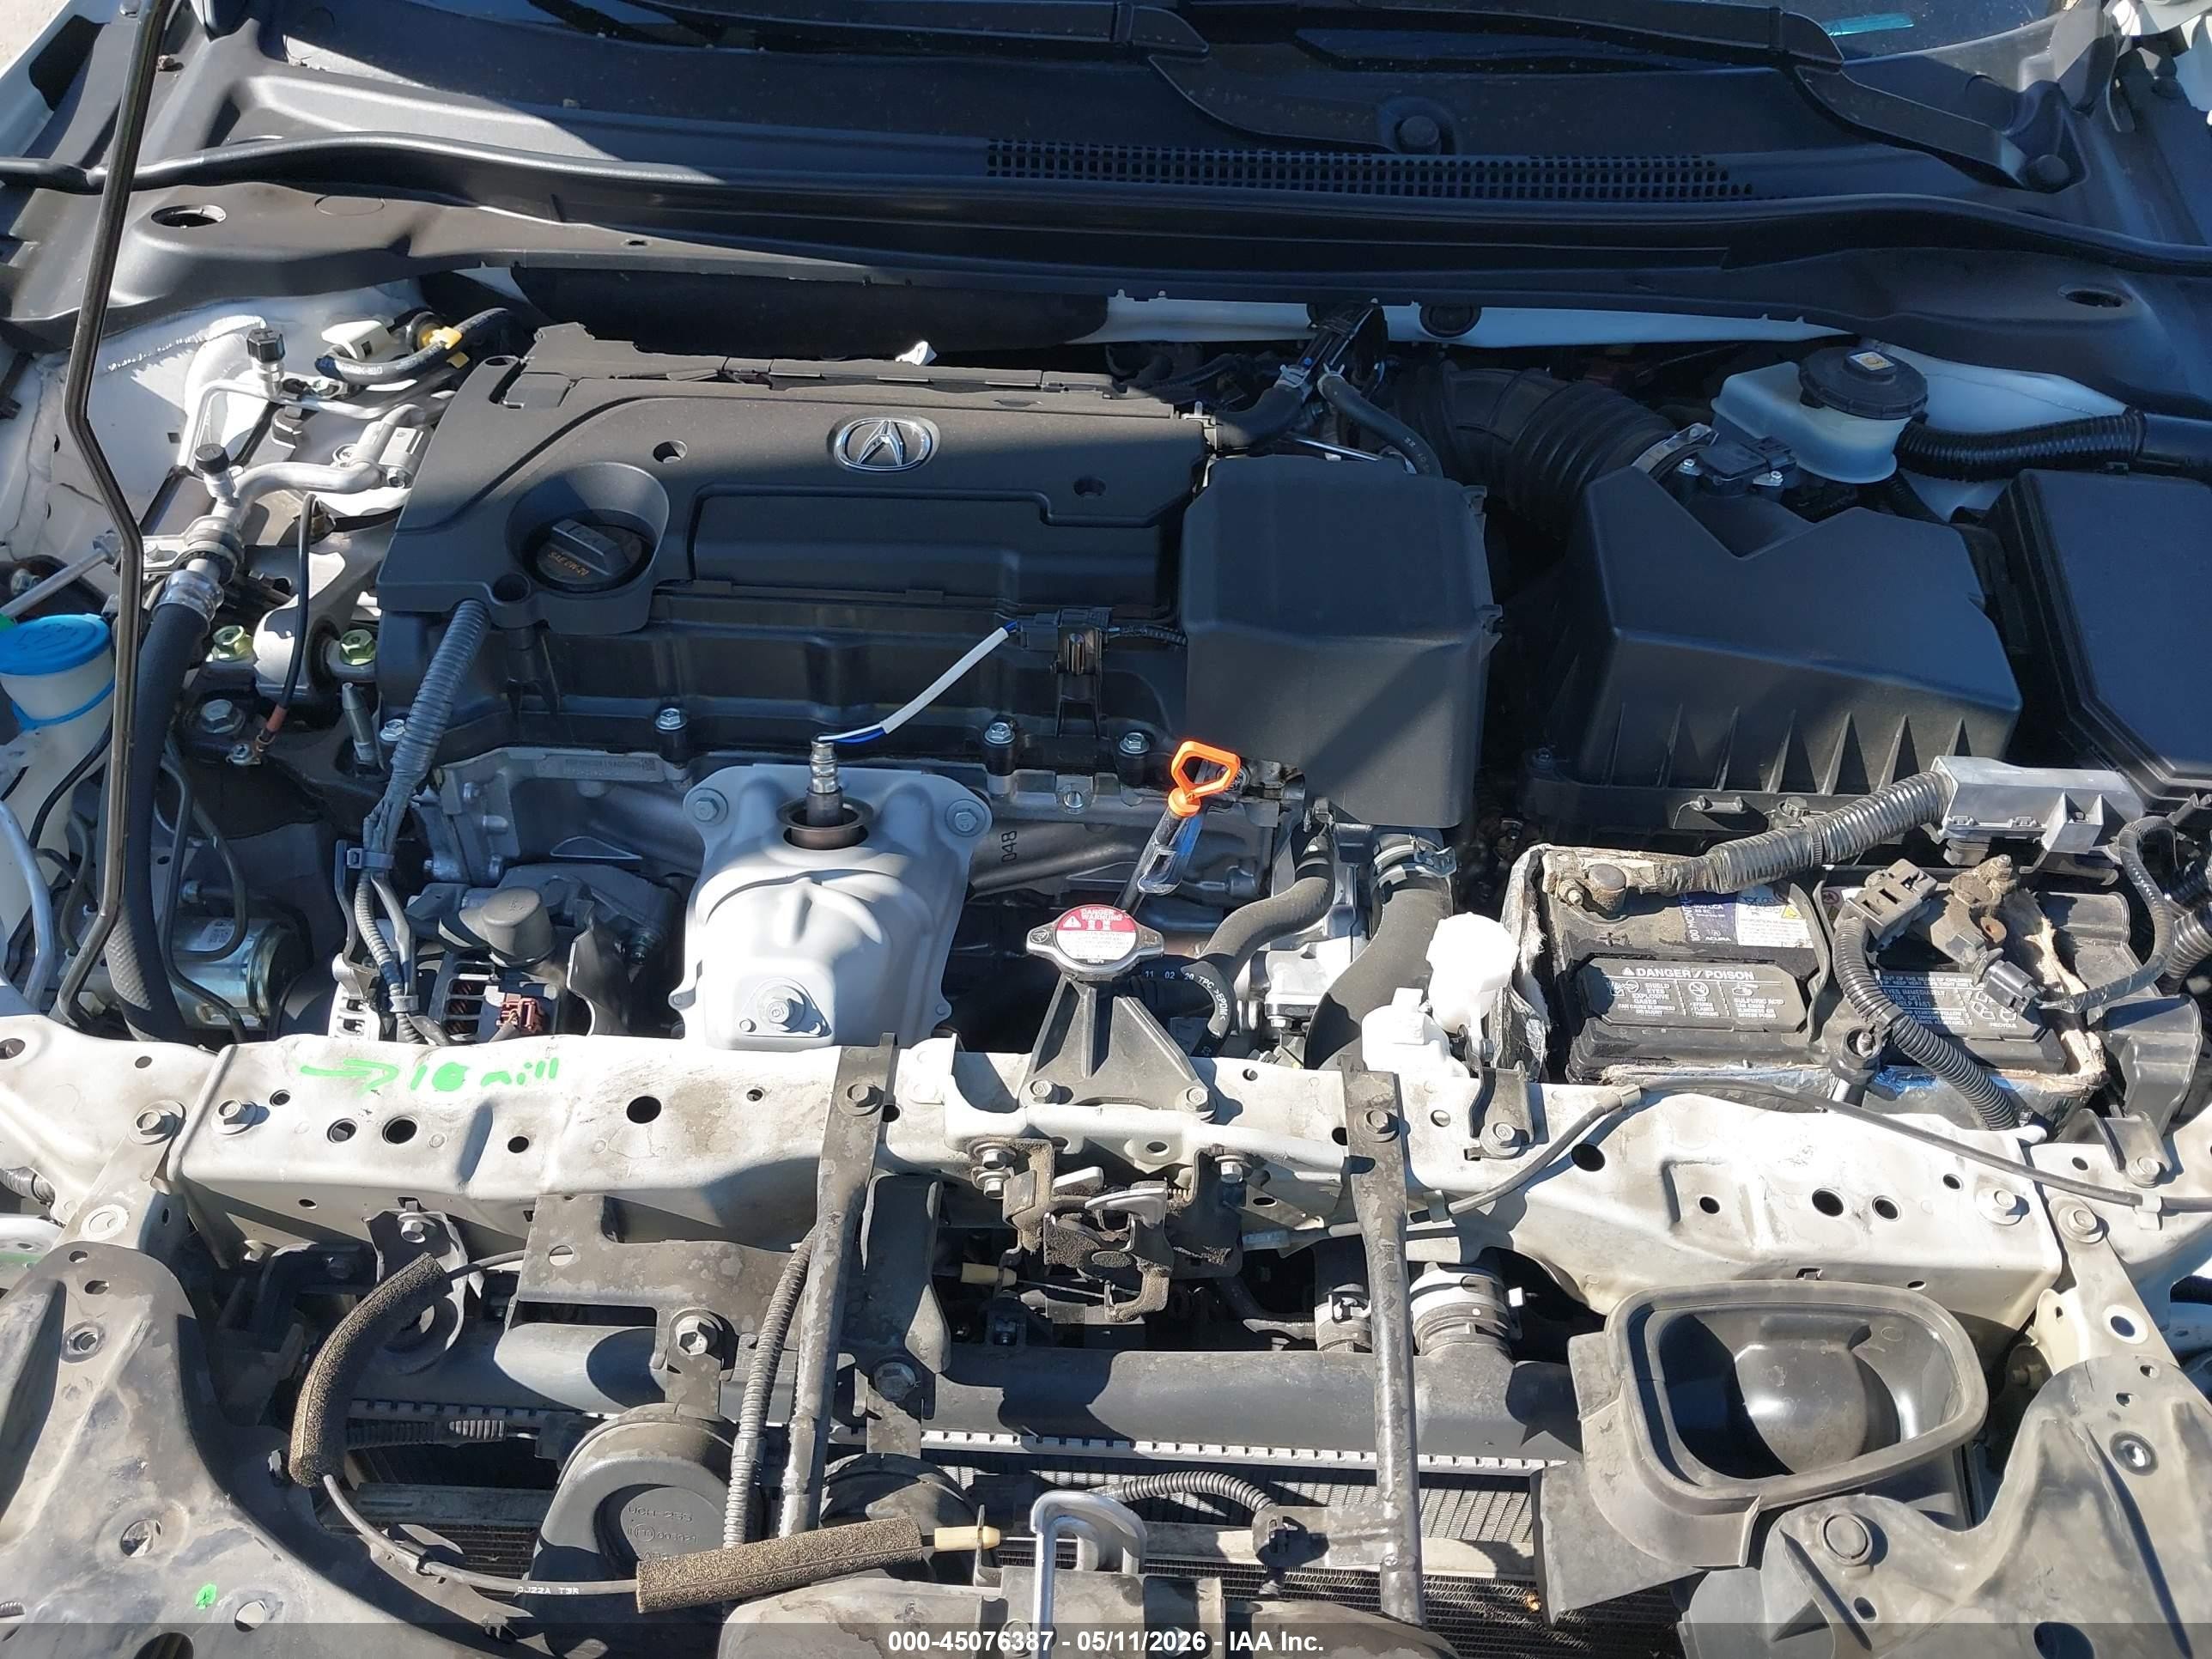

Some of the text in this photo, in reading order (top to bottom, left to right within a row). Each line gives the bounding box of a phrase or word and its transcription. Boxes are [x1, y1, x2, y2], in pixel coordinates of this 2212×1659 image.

[548, 551, 568, 563] SAE
[1001, 830, 1017, 862] 048
[1689, 929, 1700, 941] 100
[1184, 972, 1194, 981] 20
[1199, 975, 1215, 989] TPC
